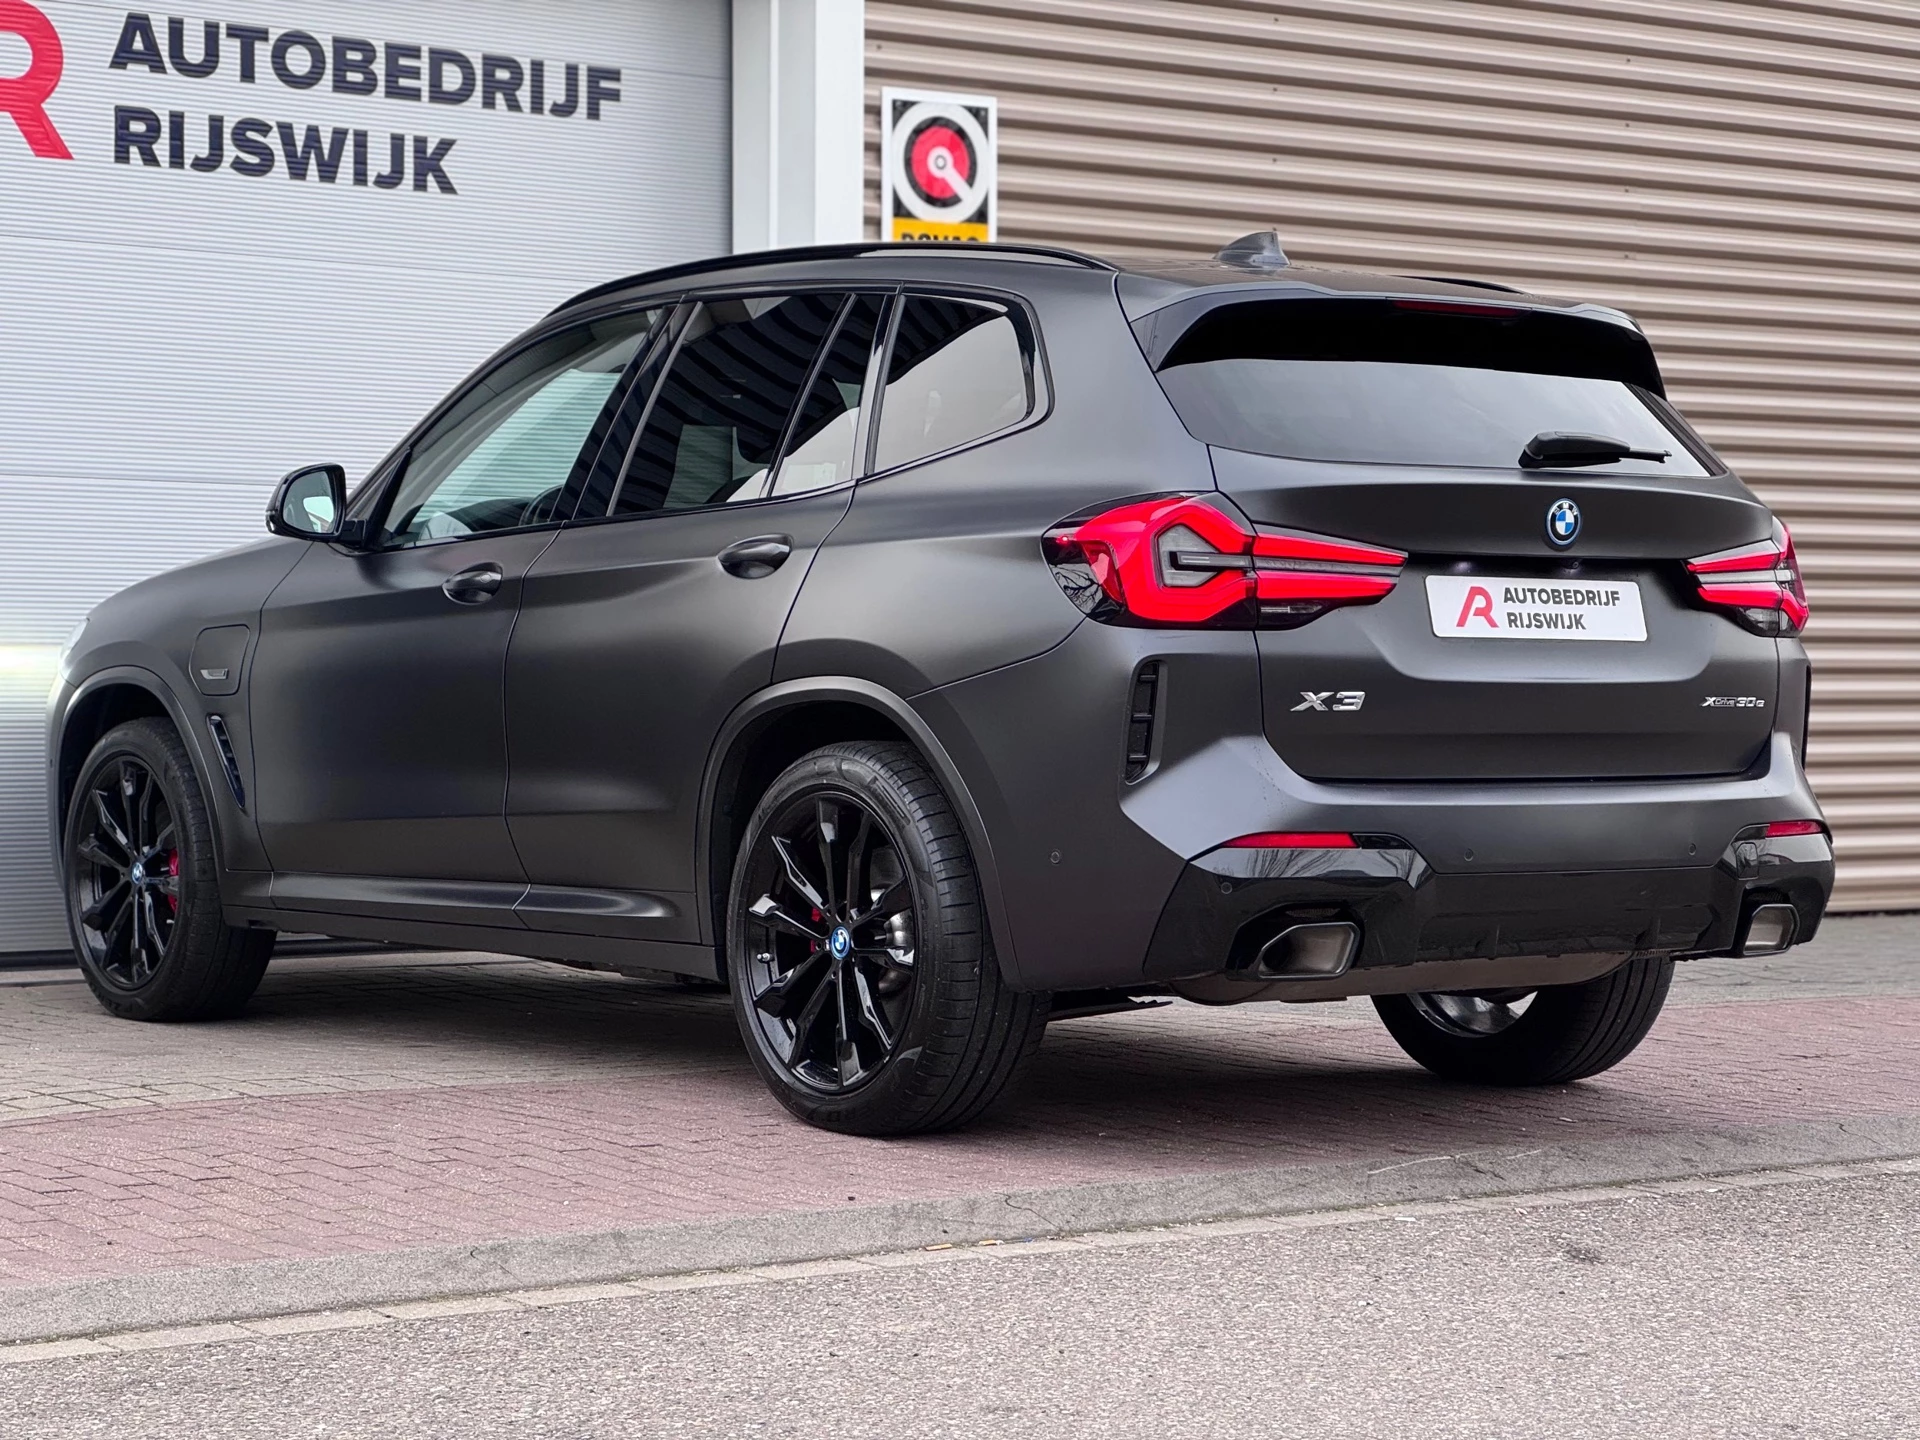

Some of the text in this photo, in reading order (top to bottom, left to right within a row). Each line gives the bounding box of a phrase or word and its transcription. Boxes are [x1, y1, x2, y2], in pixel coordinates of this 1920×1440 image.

[109, 12, 621, 120] AUTOBEDRIJF
[113, 105, 458, 195] RIJSWIJK
[1503, 587, 1620, 607] AUTOBEDRIJF
[1507, 612, 1586, 630] RIJSWIJK
[1290, 691, 1366, 711] X3
